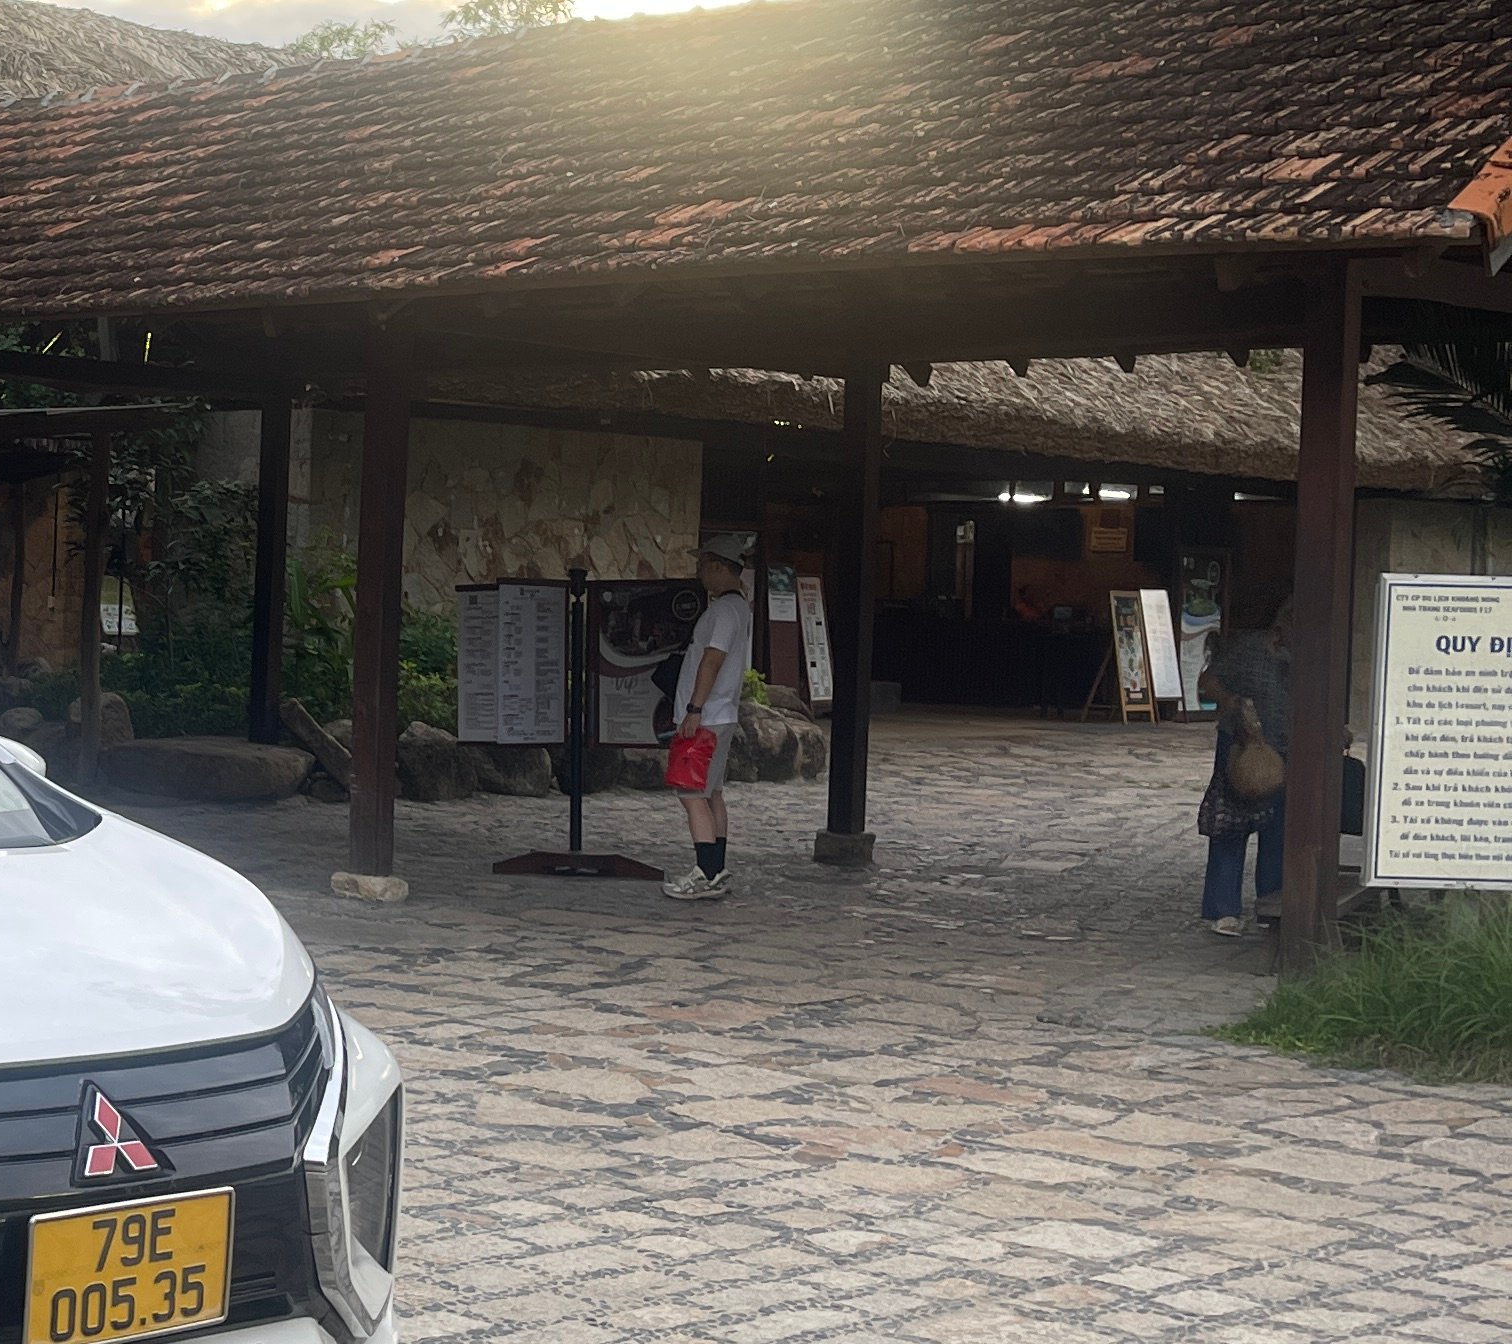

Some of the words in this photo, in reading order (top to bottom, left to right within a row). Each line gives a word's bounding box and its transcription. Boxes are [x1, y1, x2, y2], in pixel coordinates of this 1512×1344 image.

[1435, 635, 1482, 655] QUY
[92, 1208, 177, 1272] 79E
[50, 1264, 206, 1343] 005.35
